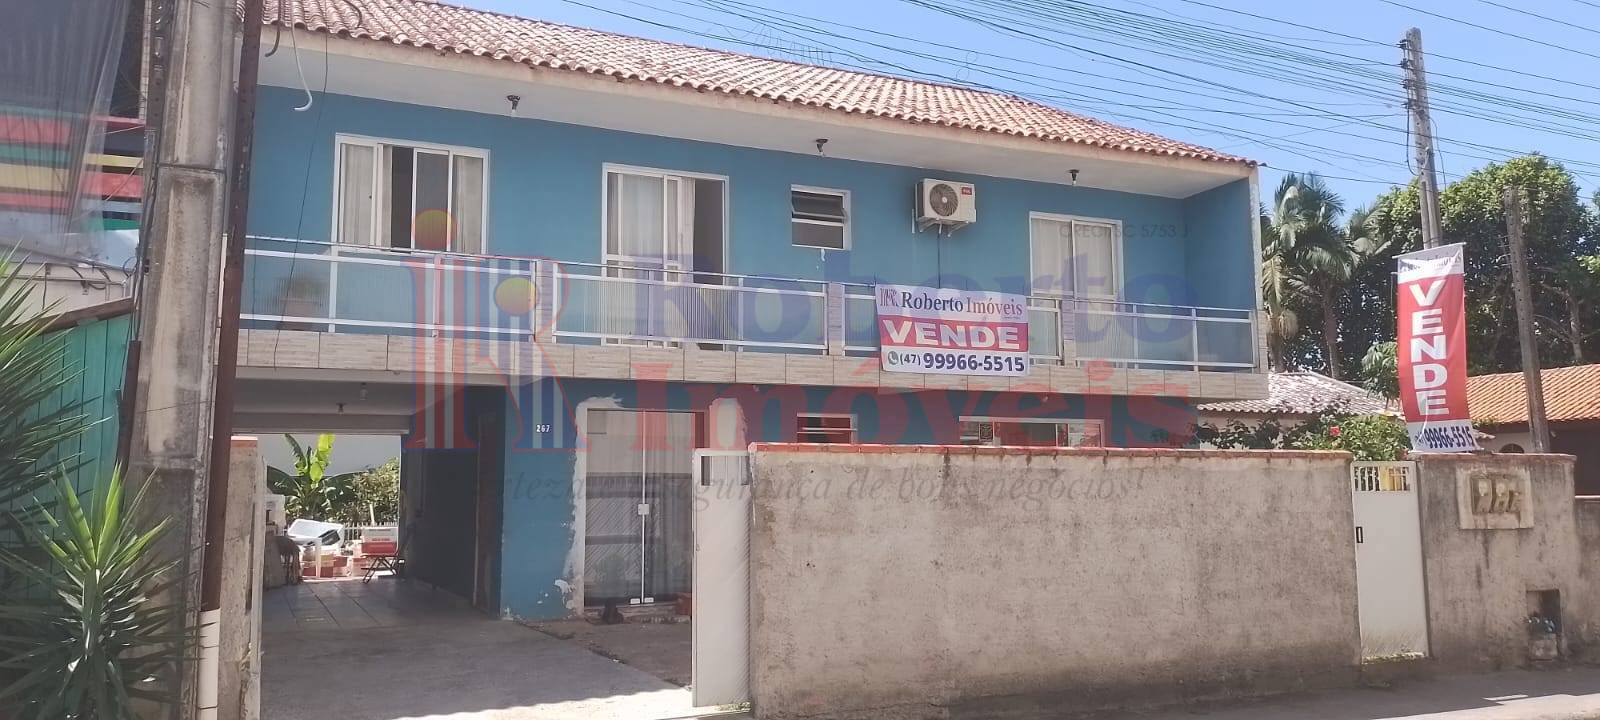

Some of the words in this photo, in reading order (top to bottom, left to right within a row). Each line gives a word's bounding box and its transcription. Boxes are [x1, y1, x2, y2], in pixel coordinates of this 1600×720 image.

[901, 291, 964, 312] Roberto
[966, 297, 1023, 316] Imóveis
[882, 319, 1020, 350] VENDE
[1408, 279, 1450, 416] VENDE
[900, 353, 921, 366] (47)
[923, 352, 1025, 372] 99966-5515
[536, 424, 551, 433] 267
